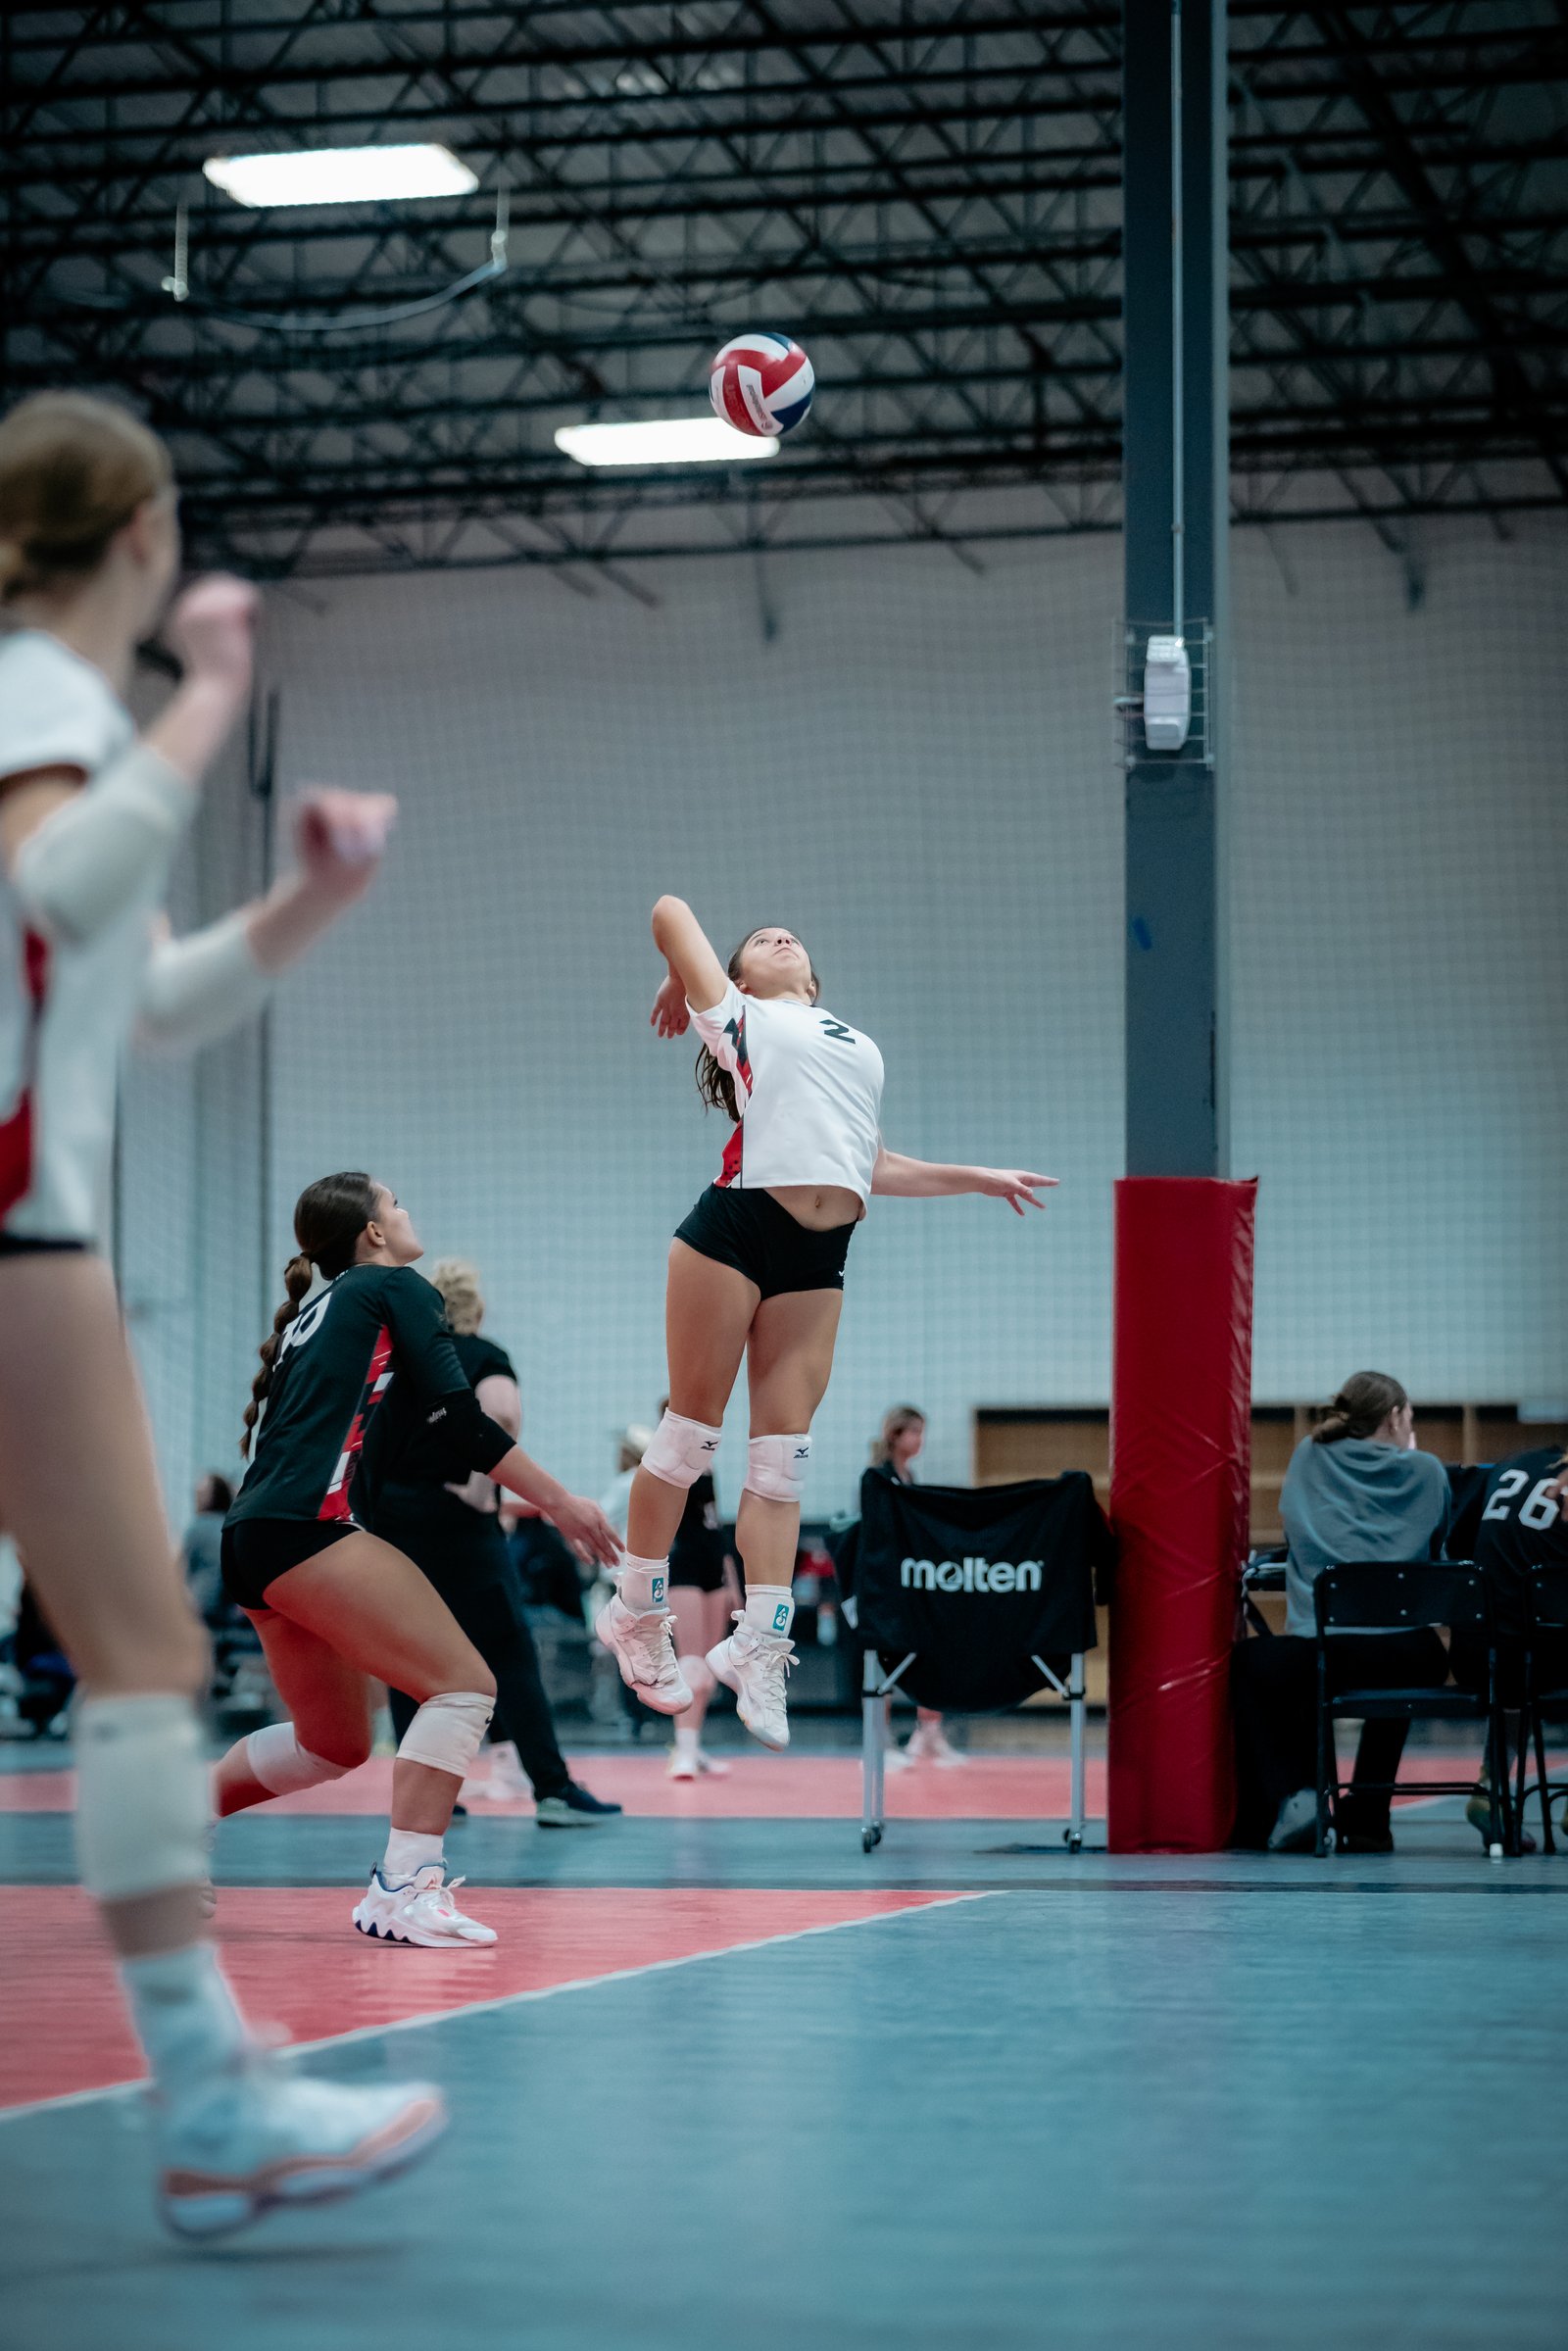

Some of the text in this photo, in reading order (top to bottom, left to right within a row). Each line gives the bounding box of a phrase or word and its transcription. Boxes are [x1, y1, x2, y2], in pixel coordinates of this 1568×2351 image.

[819, 1019, 856, 1045] 2
[1482, 1469, 1560, 1531] 26
[900, 1557, 1043, 1593] molten
